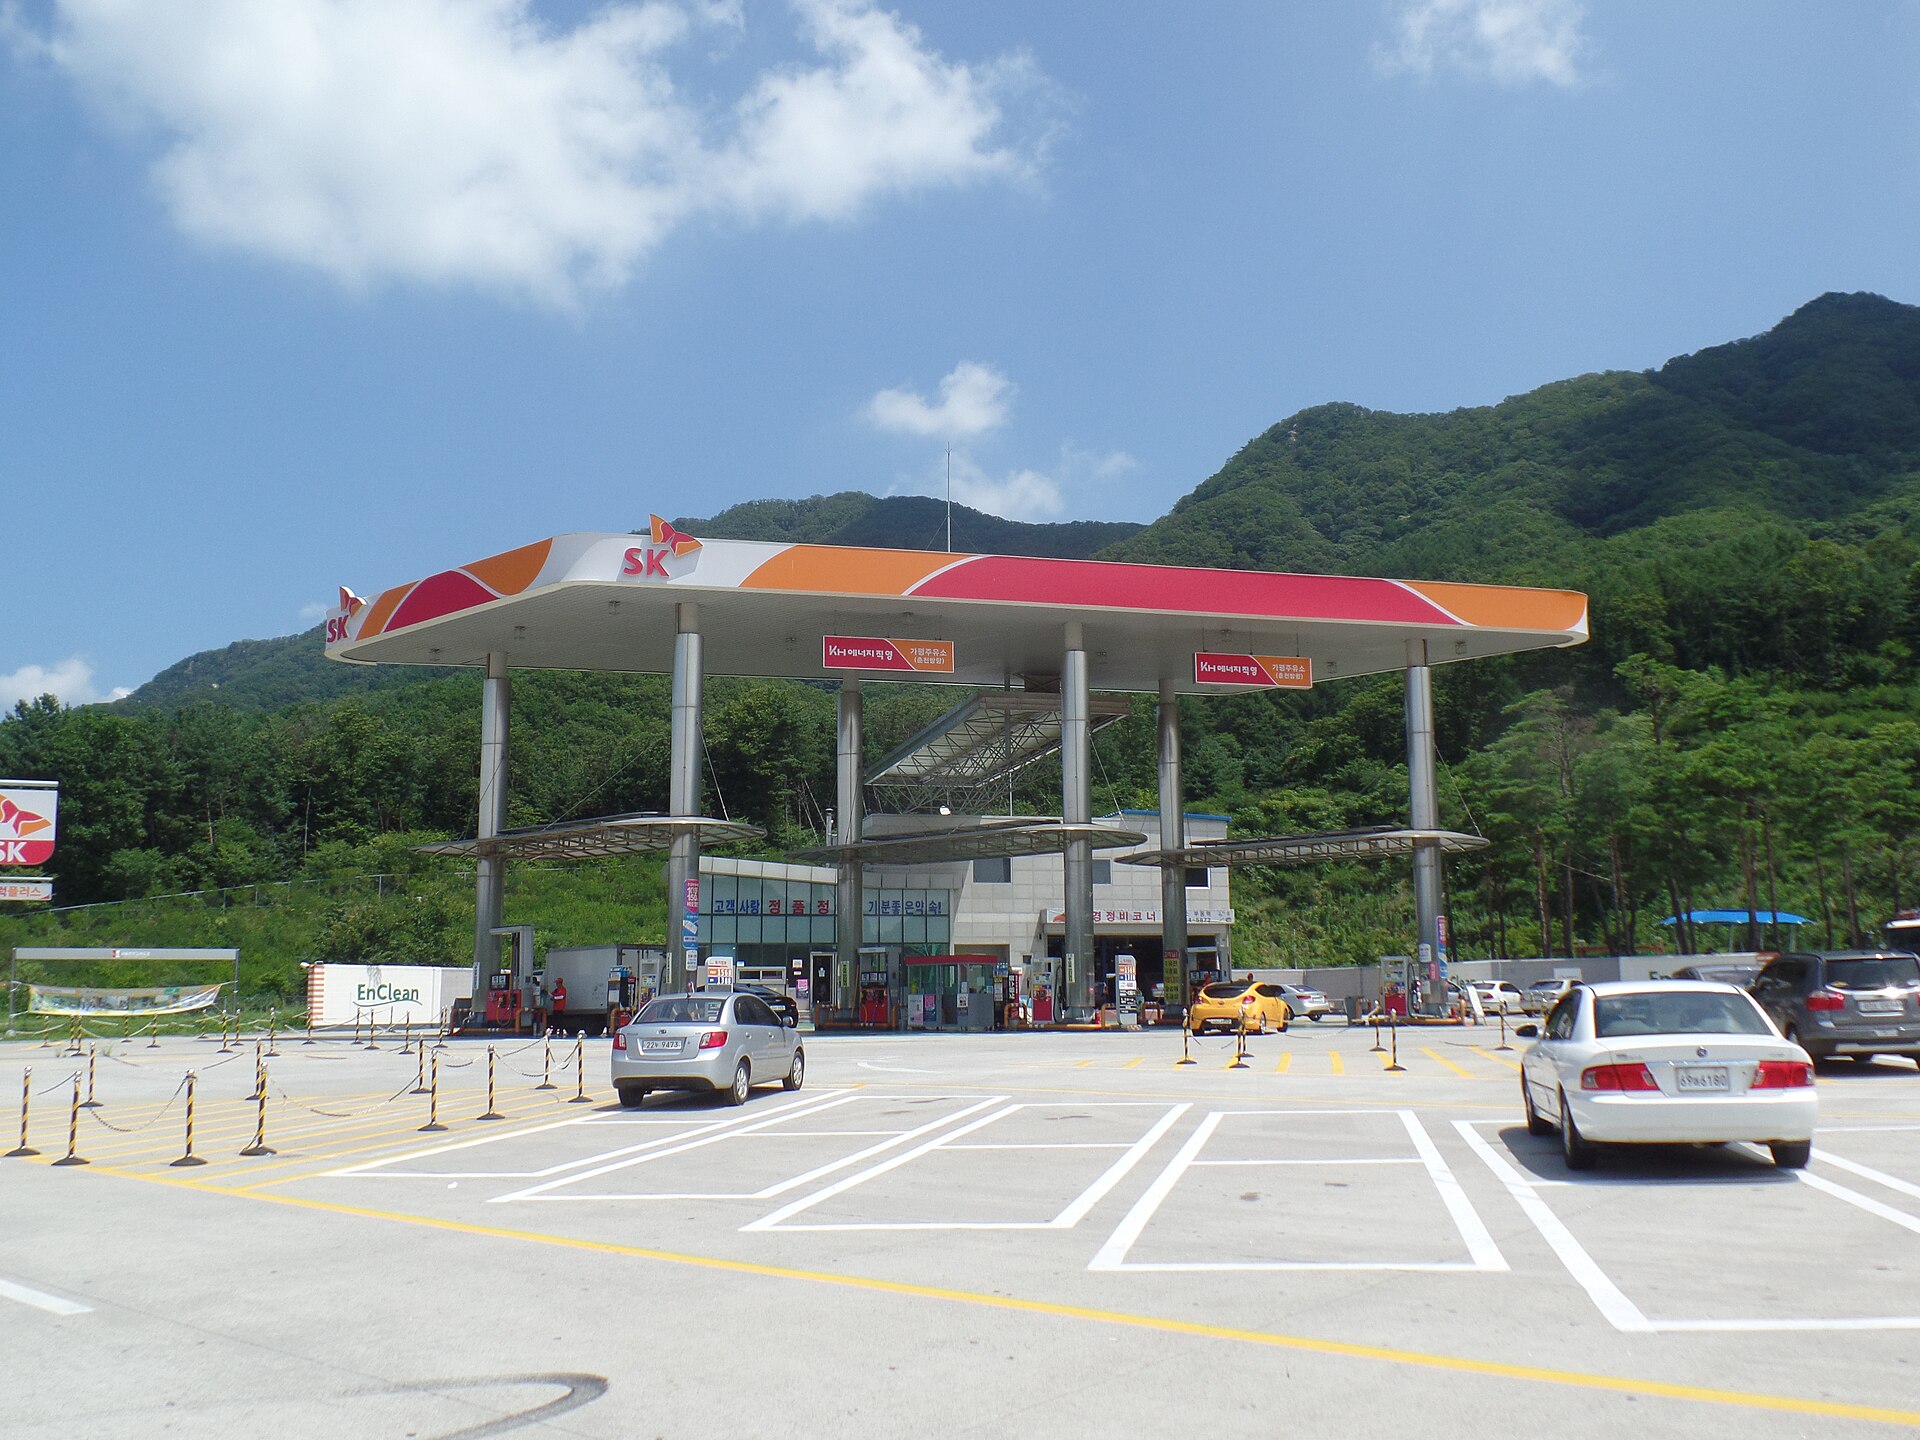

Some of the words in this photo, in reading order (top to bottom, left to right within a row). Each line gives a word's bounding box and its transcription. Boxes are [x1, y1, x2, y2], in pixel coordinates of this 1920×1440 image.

[623, 547, 670, 577] SK
[327, 614, 349, 643] SK
[357, 982, 419, 1001] EnClean
